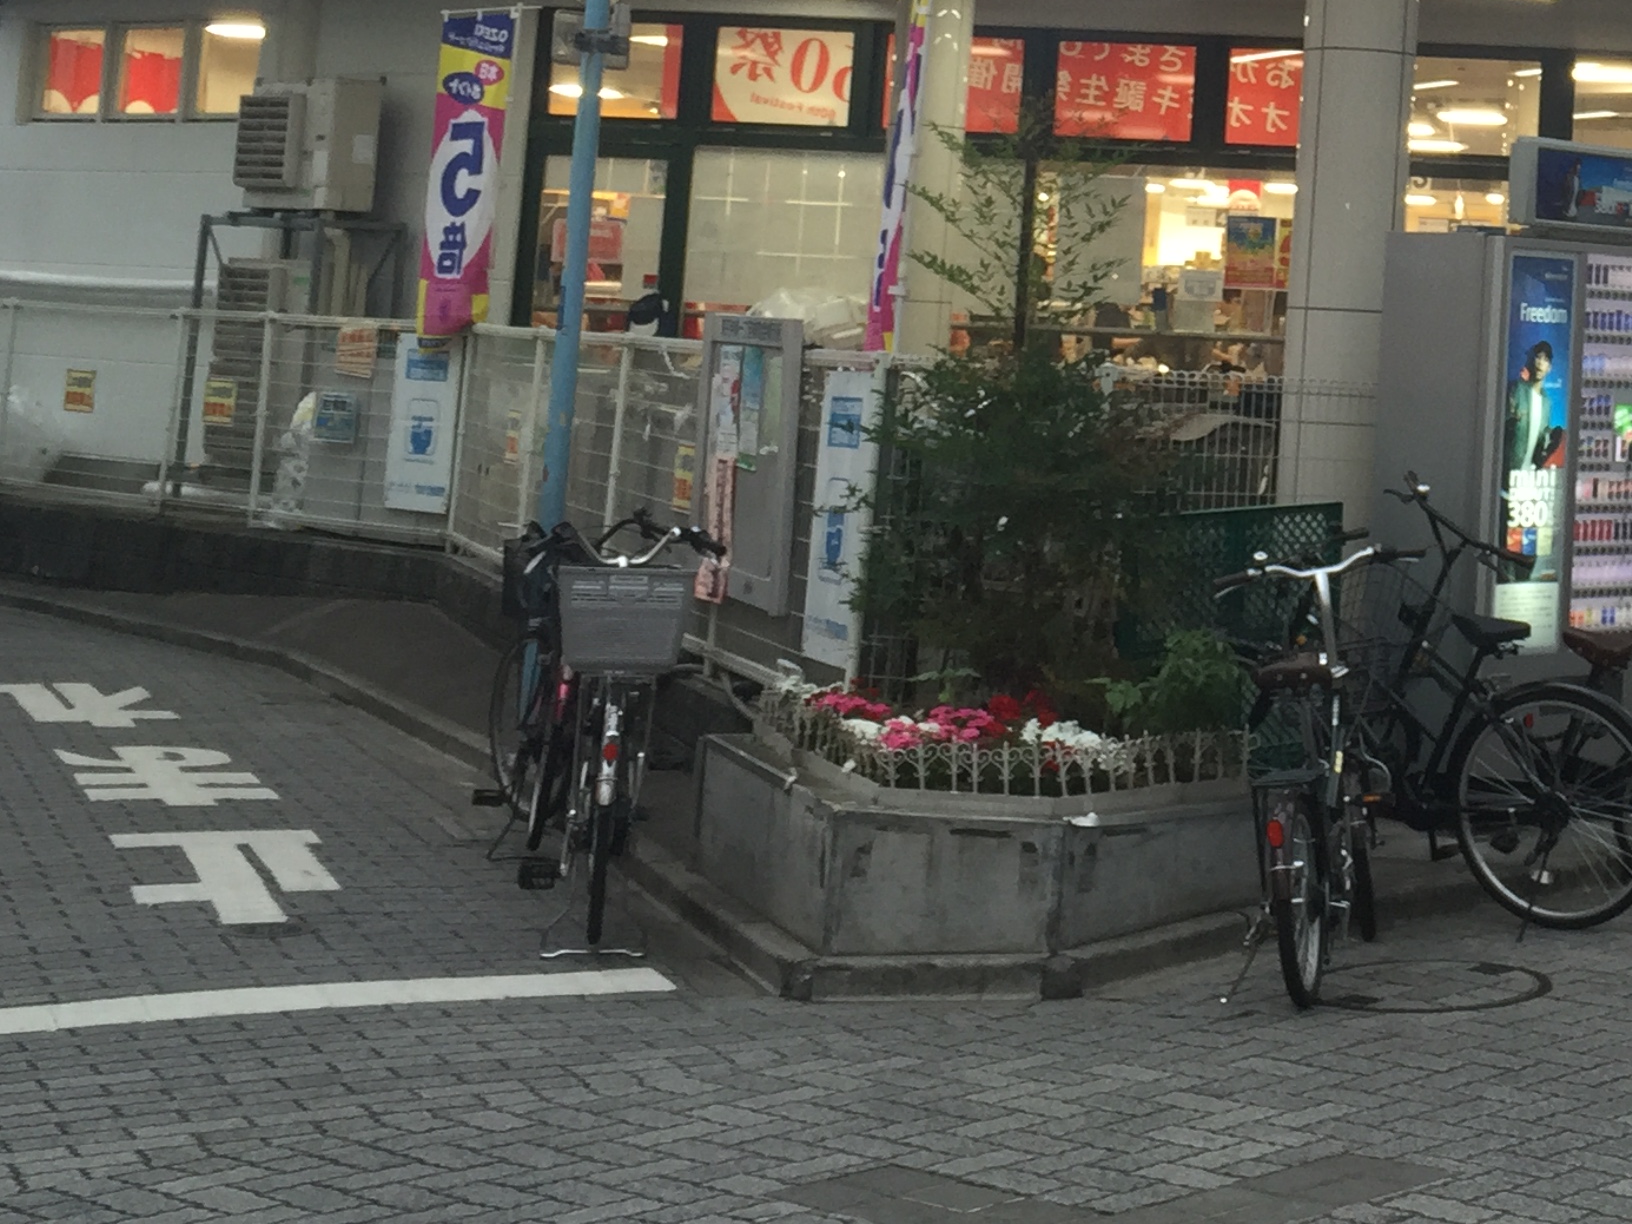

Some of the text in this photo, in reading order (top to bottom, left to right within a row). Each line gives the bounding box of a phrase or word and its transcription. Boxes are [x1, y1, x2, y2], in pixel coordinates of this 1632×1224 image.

[1519, 301, 1568, 325] Freedom
[1508, 463, 1558, 488] mini
[1507, 500, 1549, 528] 380
